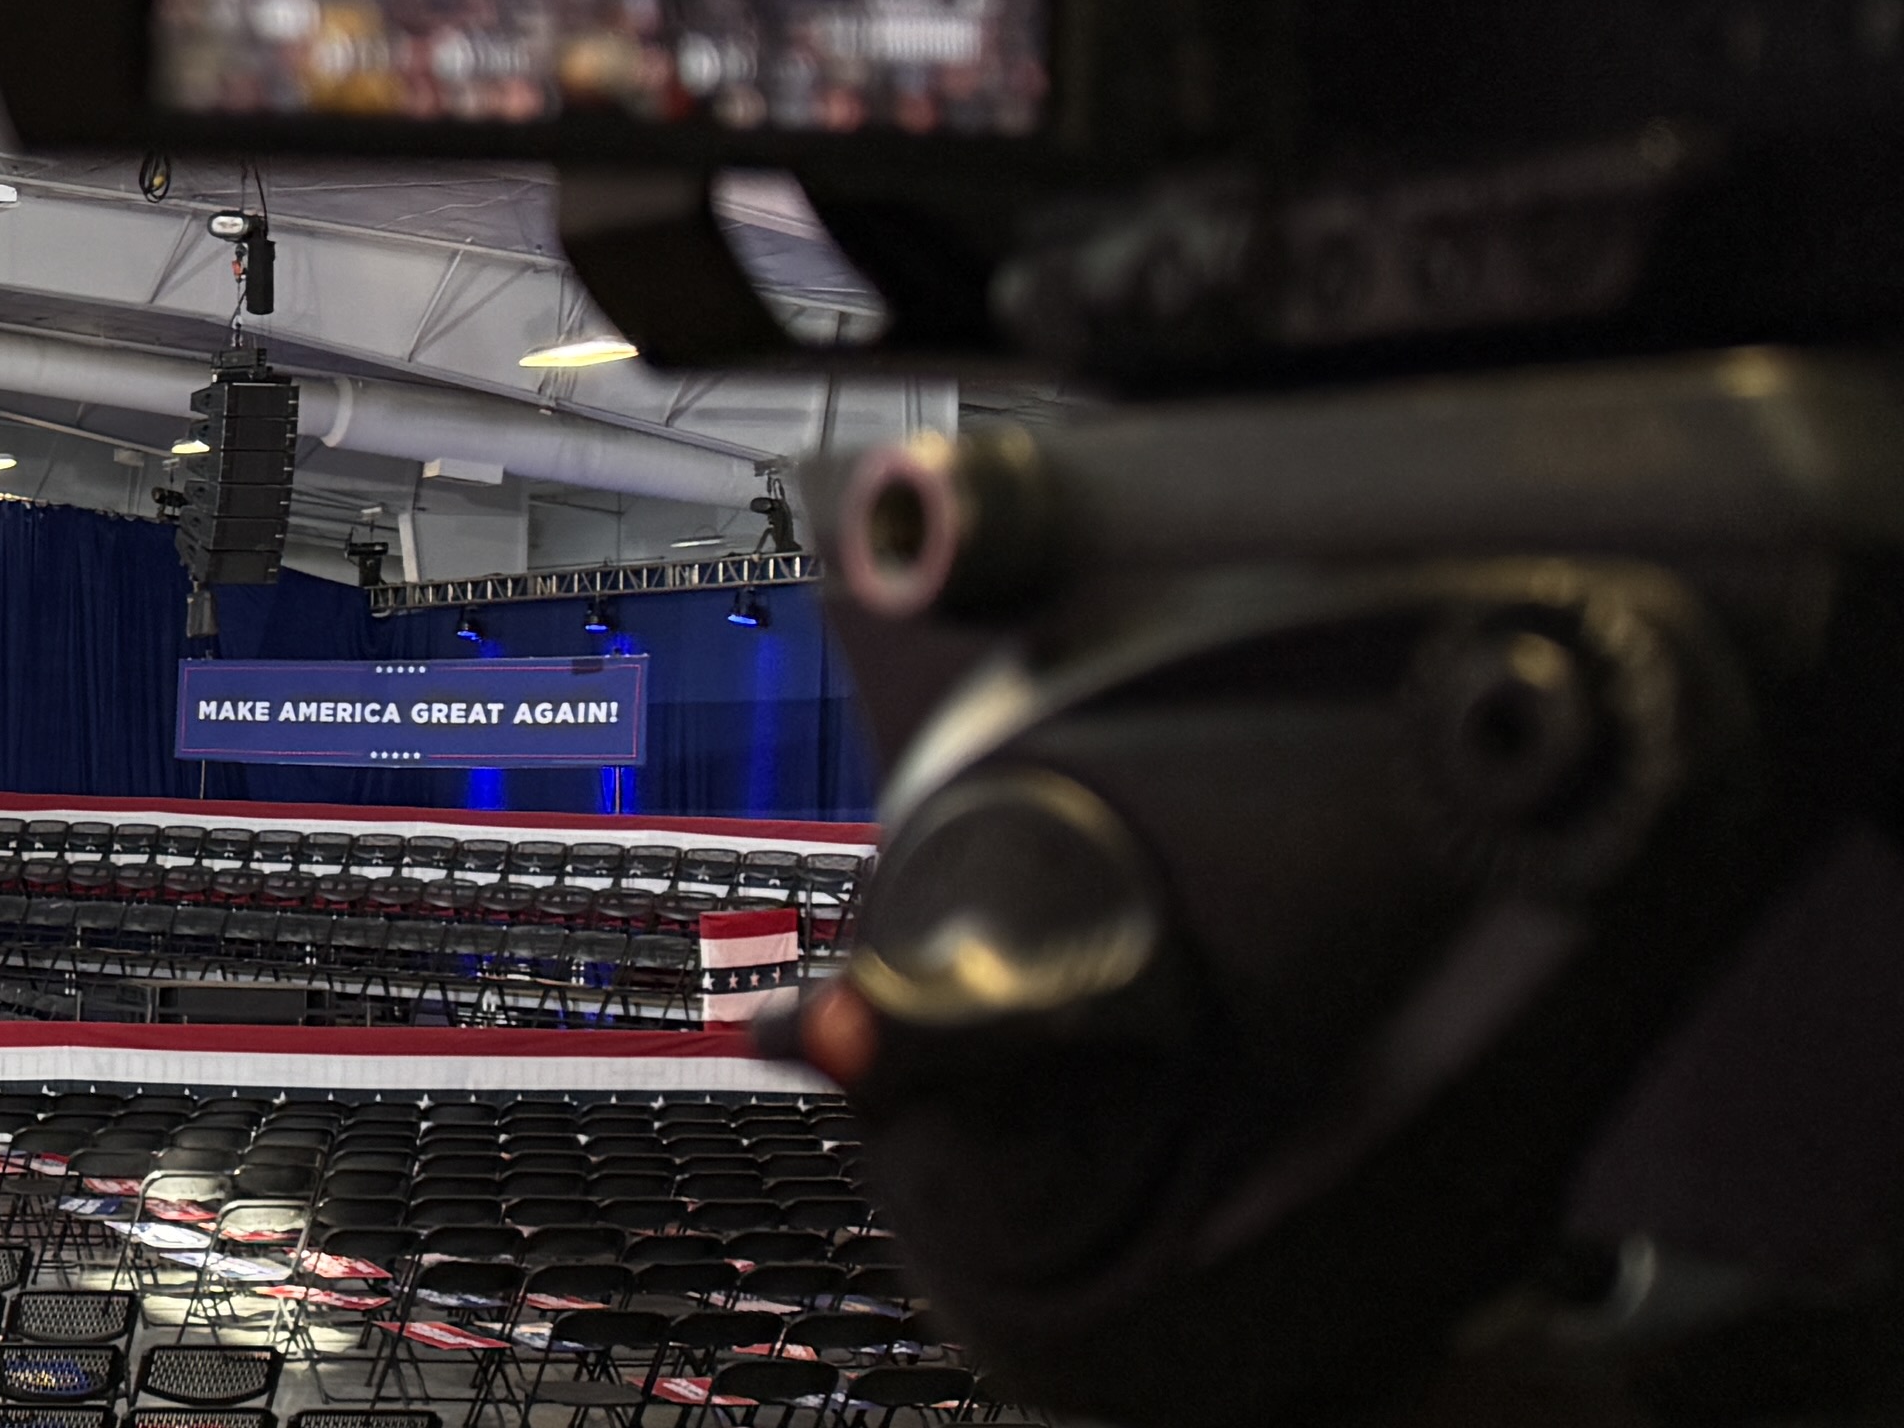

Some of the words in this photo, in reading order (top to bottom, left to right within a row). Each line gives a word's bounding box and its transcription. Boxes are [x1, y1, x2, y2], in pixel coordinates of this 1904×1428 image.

[198, 700, 270, 722] MAKE
[278, 702, 402, 724] AMERICA
[411, 702, 504, 724] GREAT
[514, 702, 619, 724] AGAIN!
